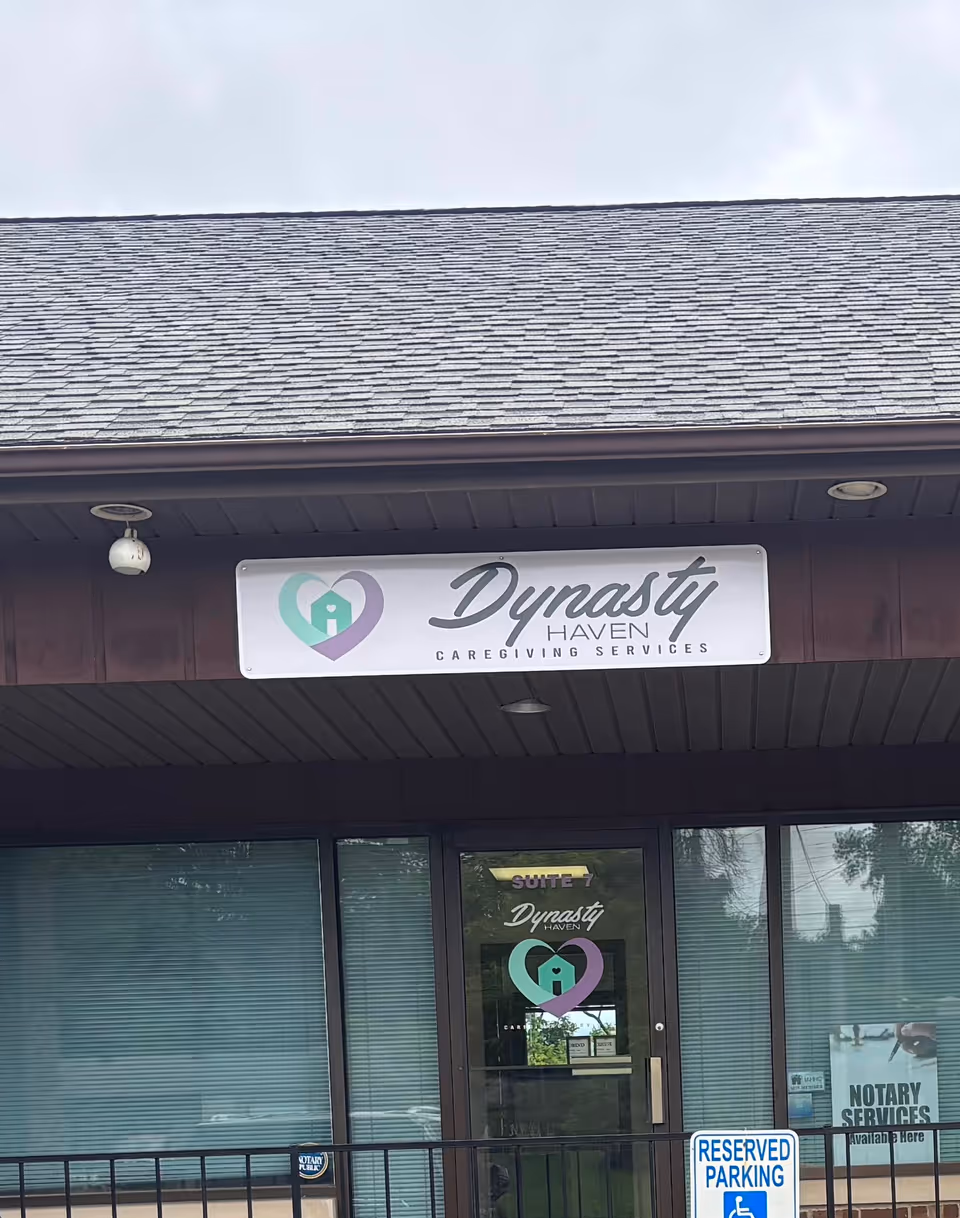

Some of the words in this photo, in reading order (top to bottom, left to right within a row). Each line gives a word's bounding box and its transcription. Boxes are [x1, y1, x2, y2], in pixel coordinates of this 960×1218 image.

[429, 556, 719, 647] Dynasty
[547, 622, 649, 641] HAVEN
[436, 647, 578, 661] CAREGIVING
[596, 643, 708, 656] SERVICES
[512, 873, 573, 889] SUITE
[583, 873, 594, 888] 7
[503, 901, 605, 933] Dynasty
[544, 923, 581, 931] HAVEN
[849, 1082, 921, 1107] NOTARY
[841, 1105, 931, 1127] SERVICES
[900, 1131, 925, 1143] Here
[698, 1138, 791, 1162] RESERVED
[706, 1164, 784, 1188] PARKING
